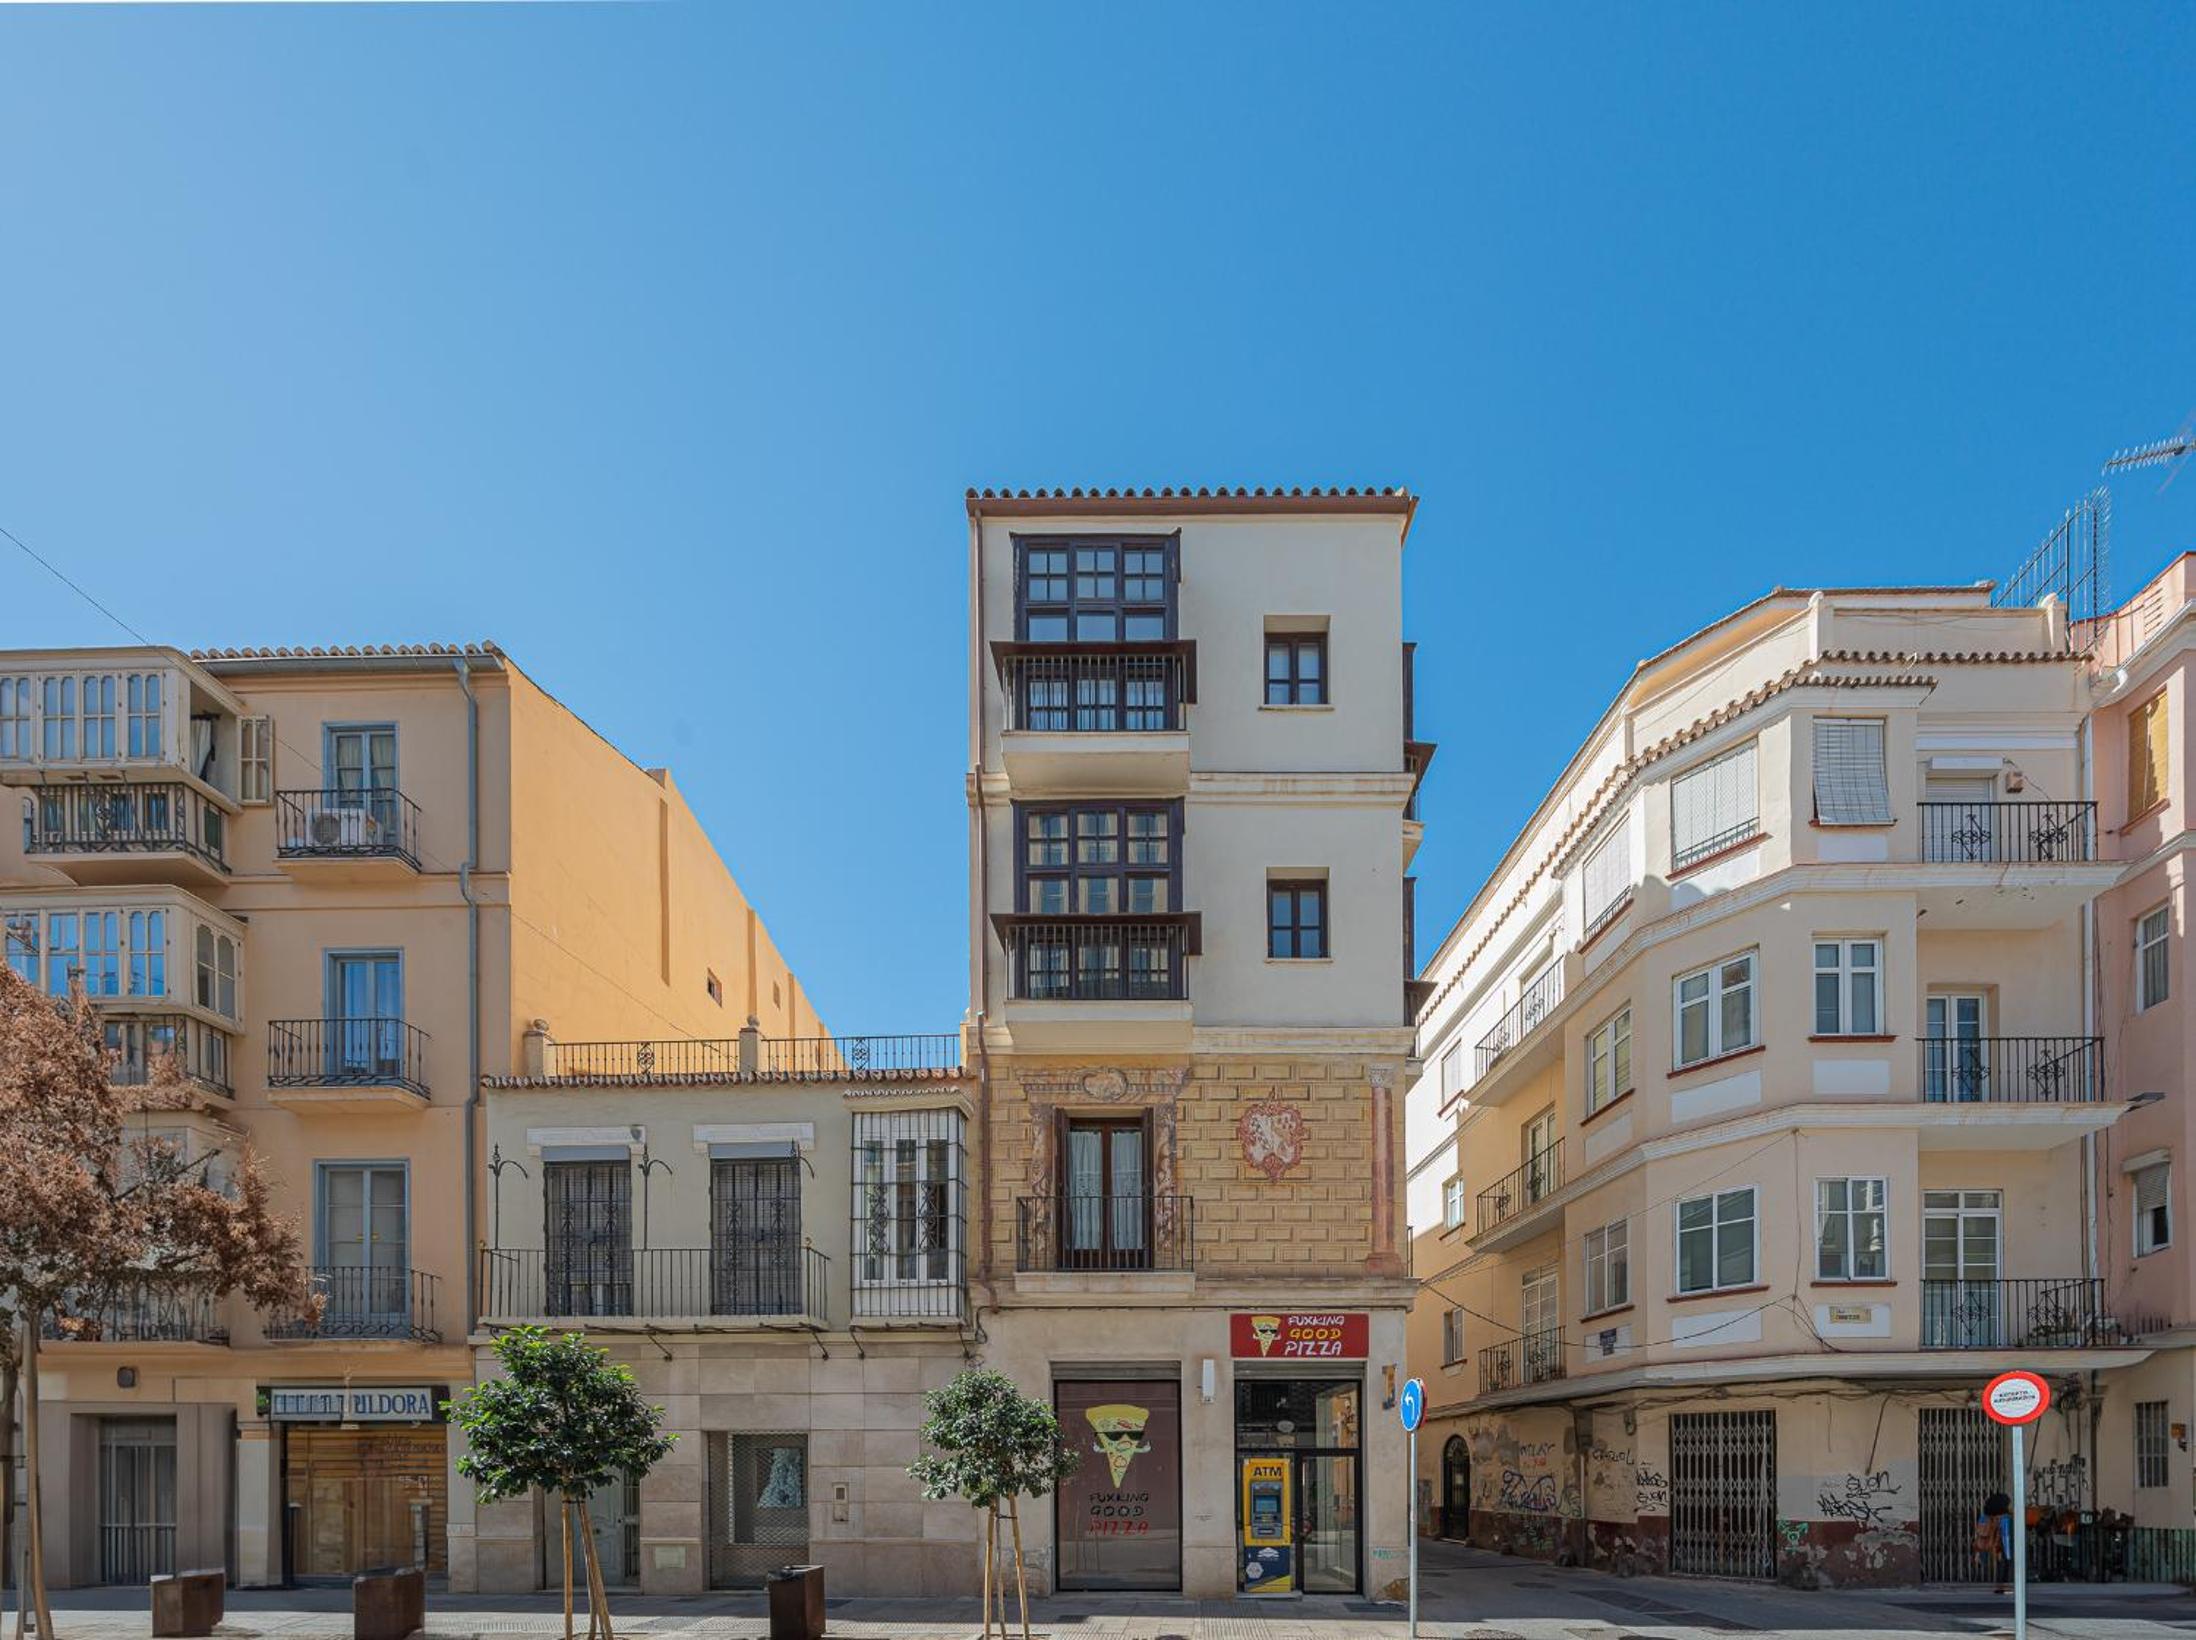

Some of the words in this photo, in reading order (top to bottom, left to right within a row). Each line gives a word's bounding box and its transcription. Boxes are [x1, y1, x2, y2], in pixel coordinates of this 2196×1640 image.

[1288, 1315, 1345, 1326] FUXKING
[1290, 1328, 1342, 1340] GOOD
[1284, 1341, 1342, 1356] PIZZA
[1253, 1466, 1282, 1477] ATM
[1091, 1505, 1144, 1517] GOOD
[1089, 1520, 1149, 1536] PIZZA
